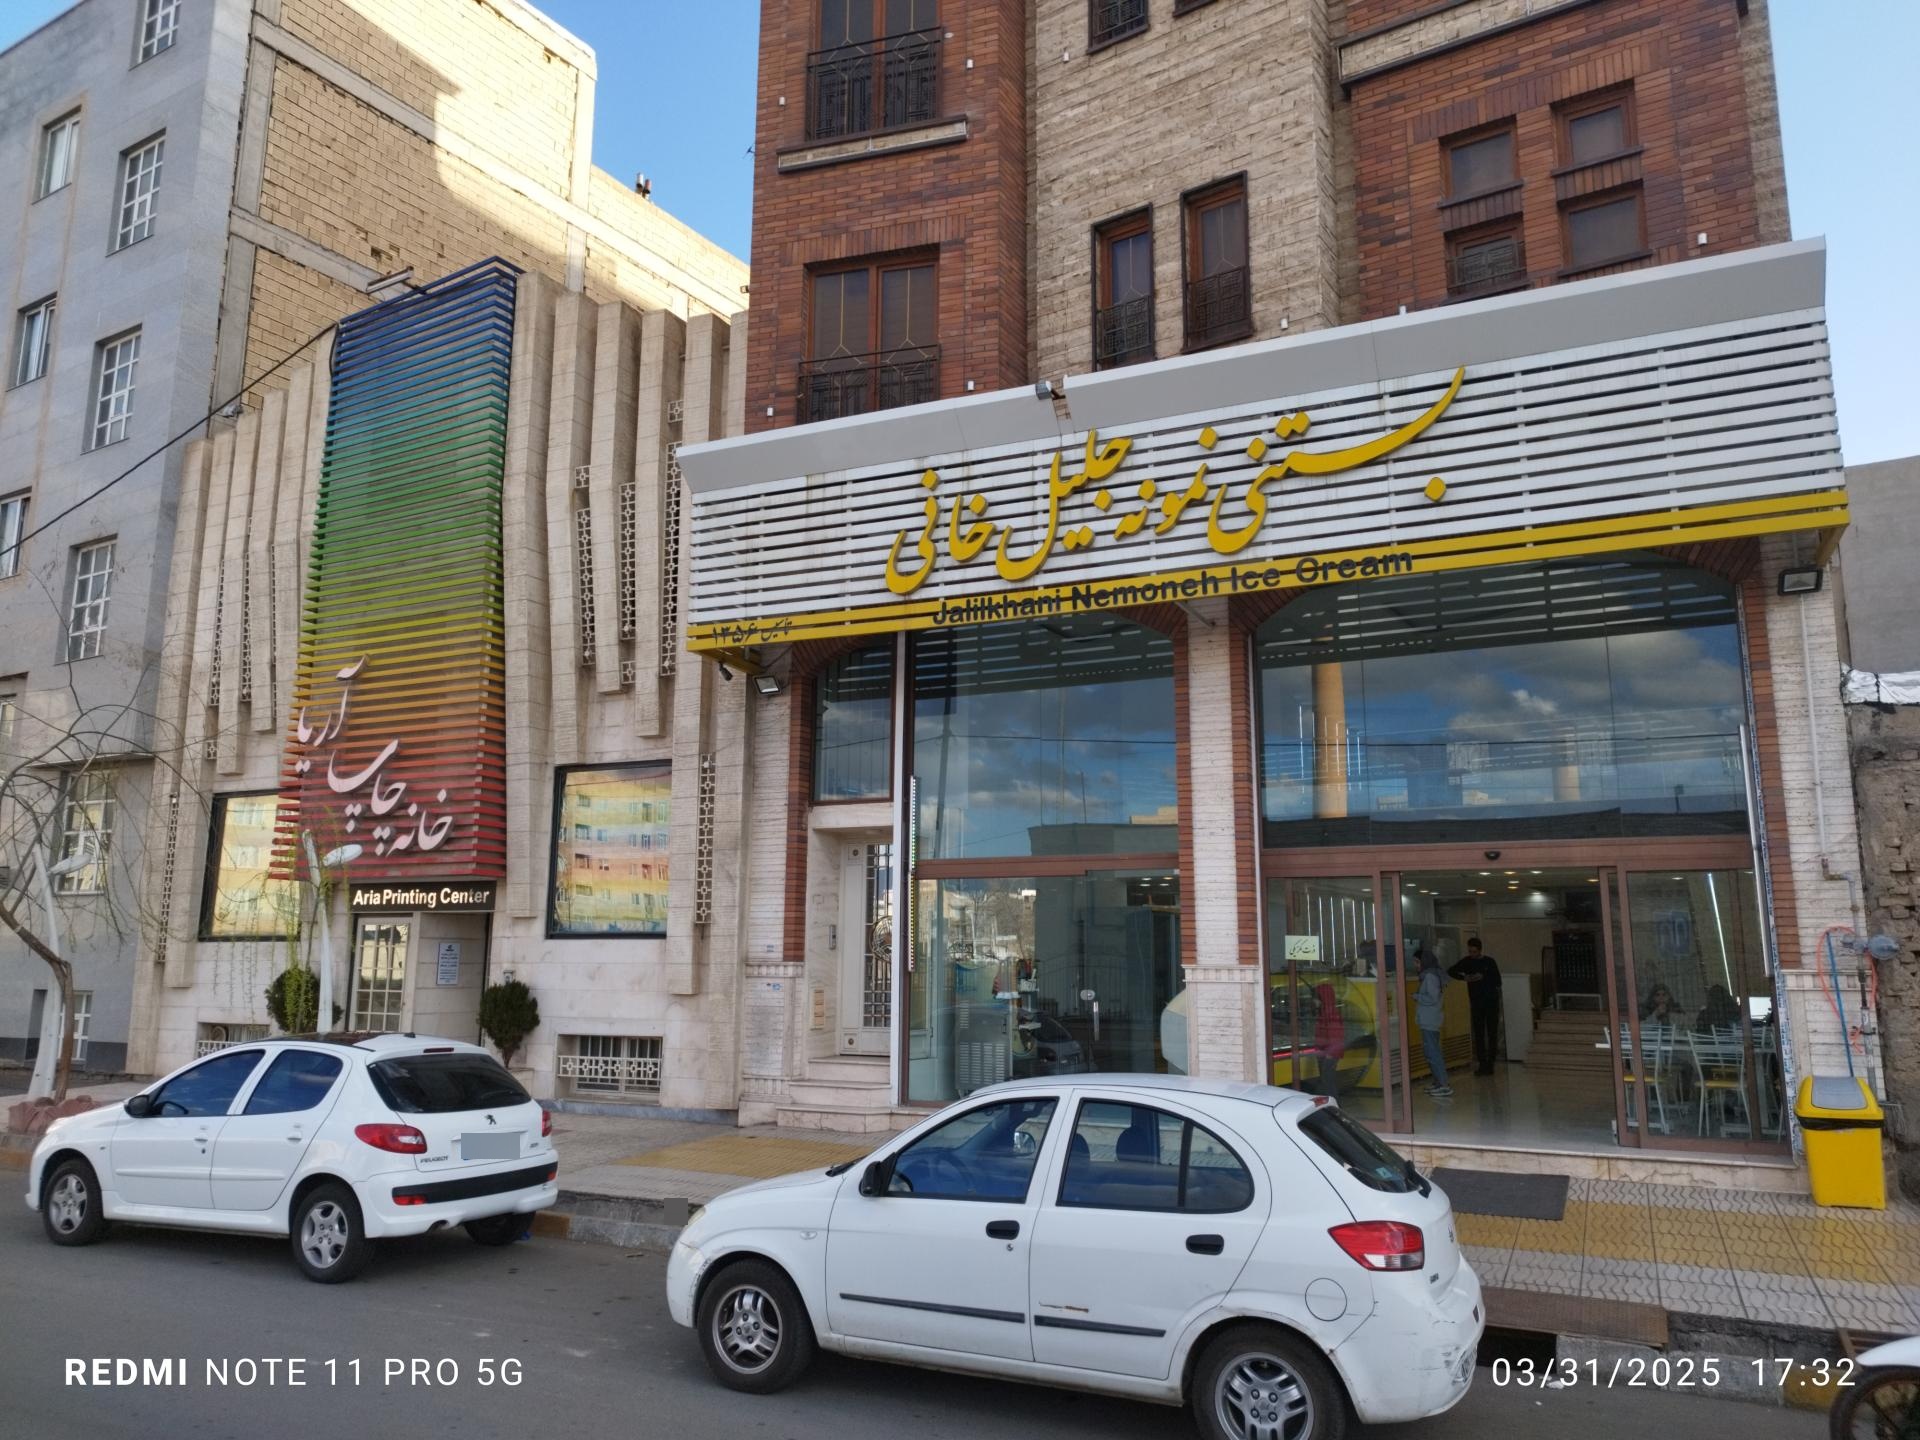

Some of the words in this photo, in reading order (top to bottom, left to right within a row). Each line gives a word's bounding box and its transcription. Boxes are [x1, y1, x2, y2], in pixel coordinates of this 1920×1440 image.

[995, 425, 1134, 582] جلیل
[1113, 426, 1219, 541] نمونه
[1207, 364, 1466, 555] بستنی
[885, 468, 996, 594] خانی
[933, 588, 1061, 625] Jalilkhani
[1071, 568, 1220, 610] Nemoneh
[1230, 566, 1281, 591] Ice
[1295, 551, 1413, 583] Cream
[294, 653, 369, 773] آریا
[327, 738, 407, 856] چاپ
[385, 788, 453, 858] خانه
[352, 889, 381, 906] Aria
[382, 889, 437, 909] Printing
[440, 887, 490, 904] Center
